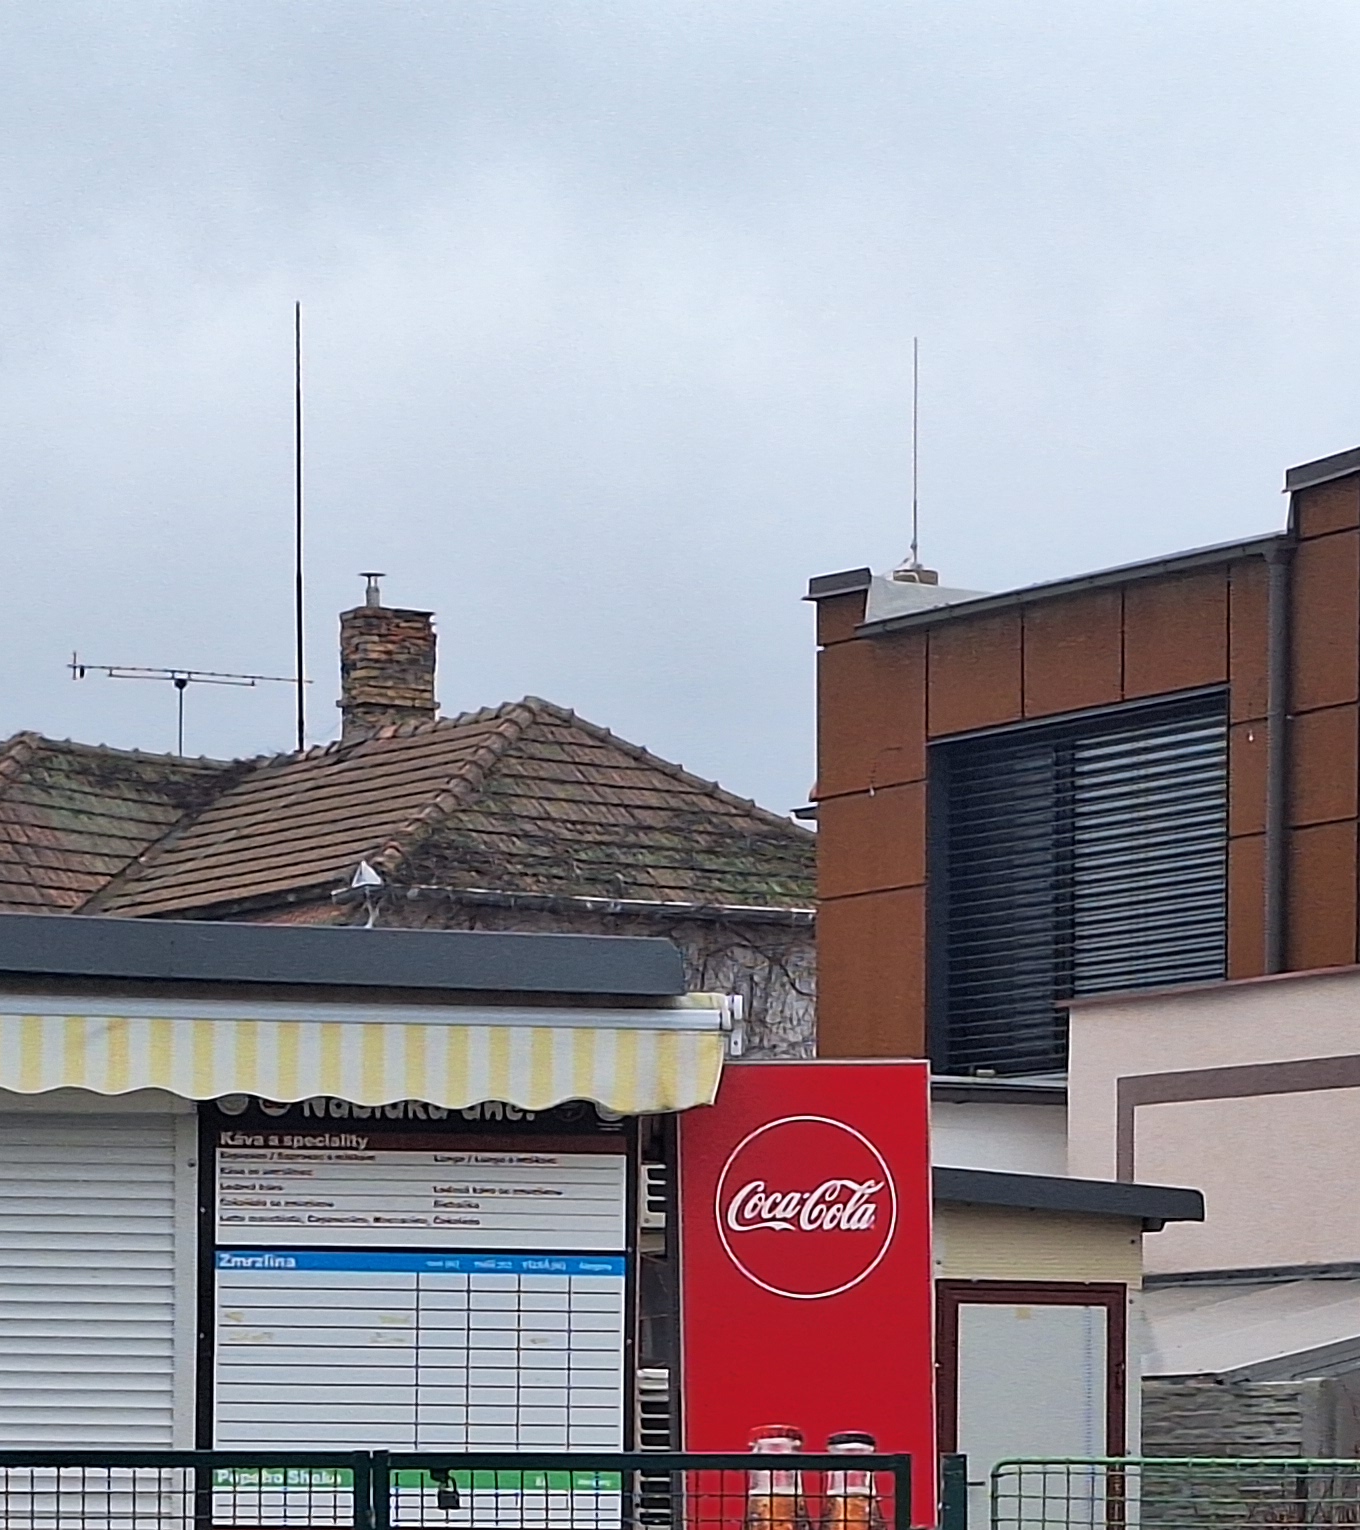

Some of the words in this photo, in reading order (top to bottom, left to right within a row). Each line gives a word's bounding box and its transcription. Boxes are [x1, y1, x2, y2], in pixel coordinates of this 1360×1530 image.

[220, 1131, 264, 1146] Káva
[268, 1134, 279, 1146] a
[282, 1133, 368, 1149] speciality
[726, 1179, 885, 1231] Coca-Cola
[219, 1253, 296, 1269] Zmrzlina
